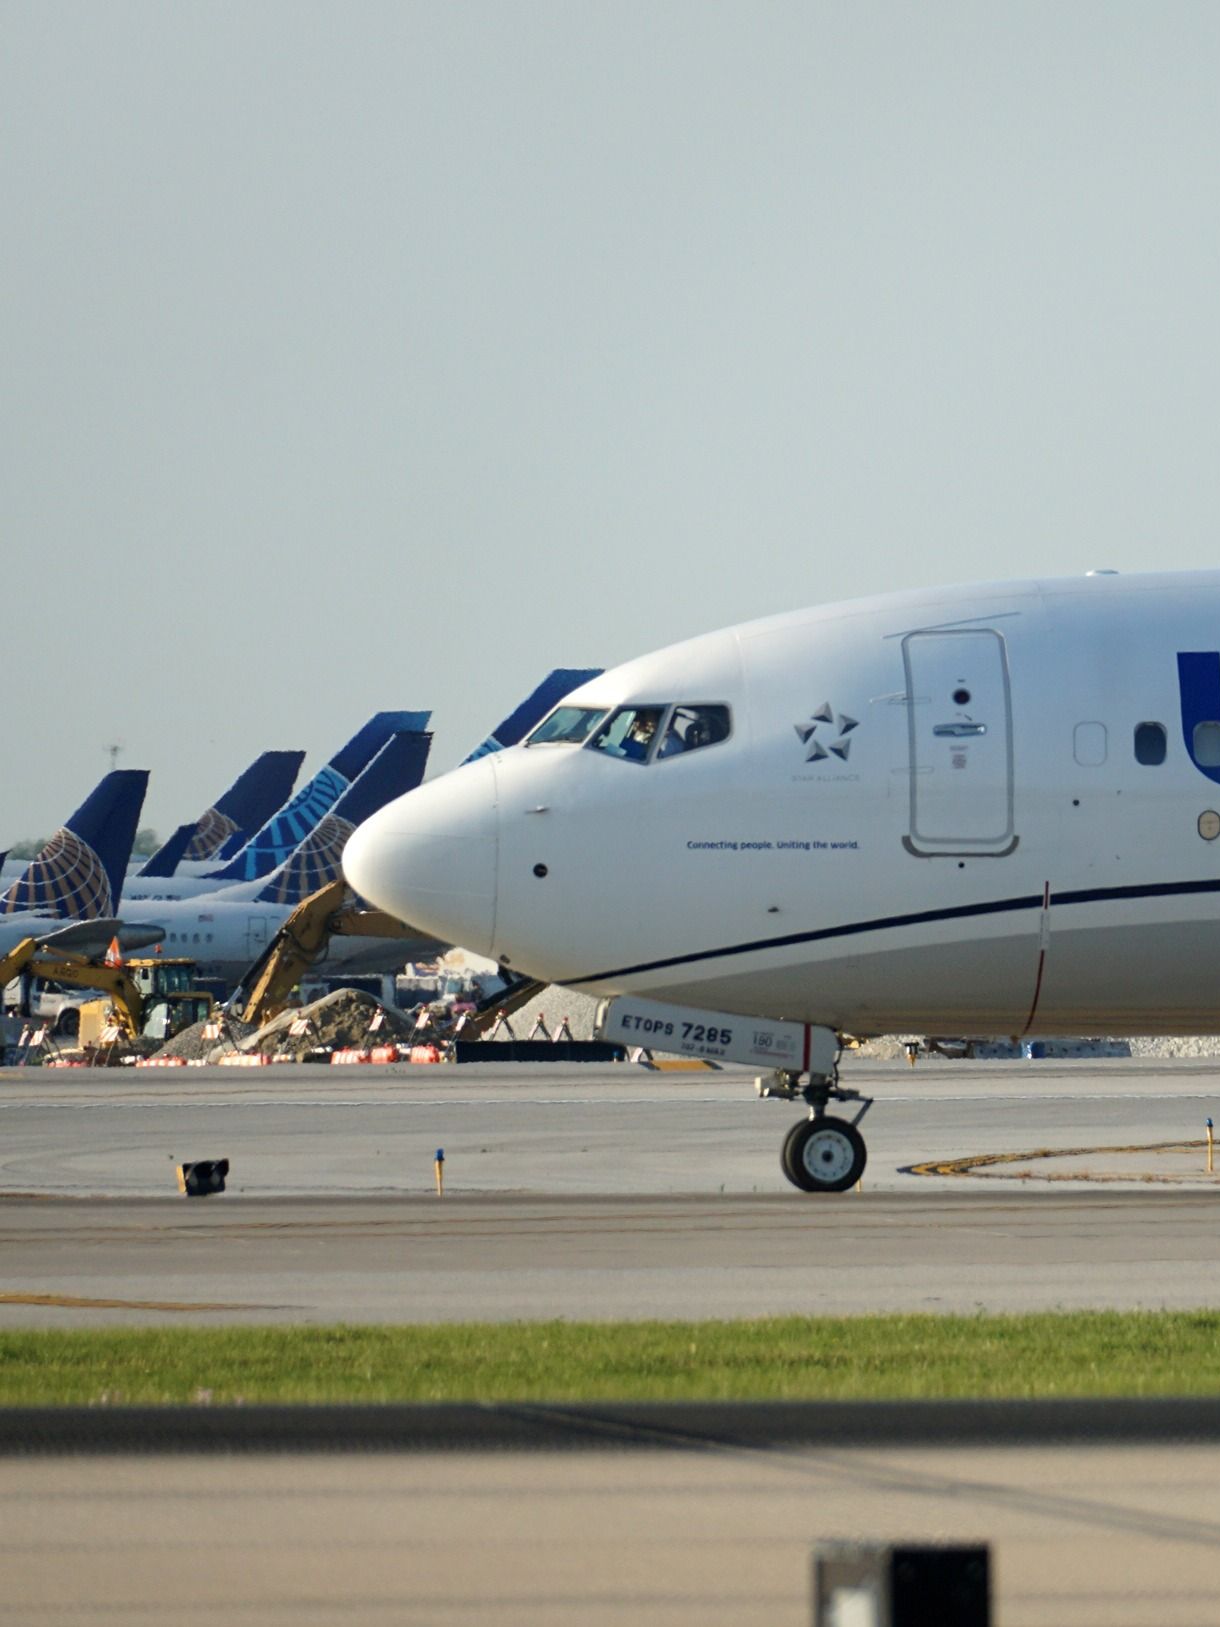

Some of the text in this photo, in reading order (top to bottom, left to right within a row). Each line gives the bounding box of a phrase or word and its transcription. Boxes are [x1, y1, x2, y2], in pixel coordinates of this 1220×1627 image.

[686, 840, 861, 851] Connecting people. Uniting the world.
[620, 1014, 733, 1045] ETOPS 7285
